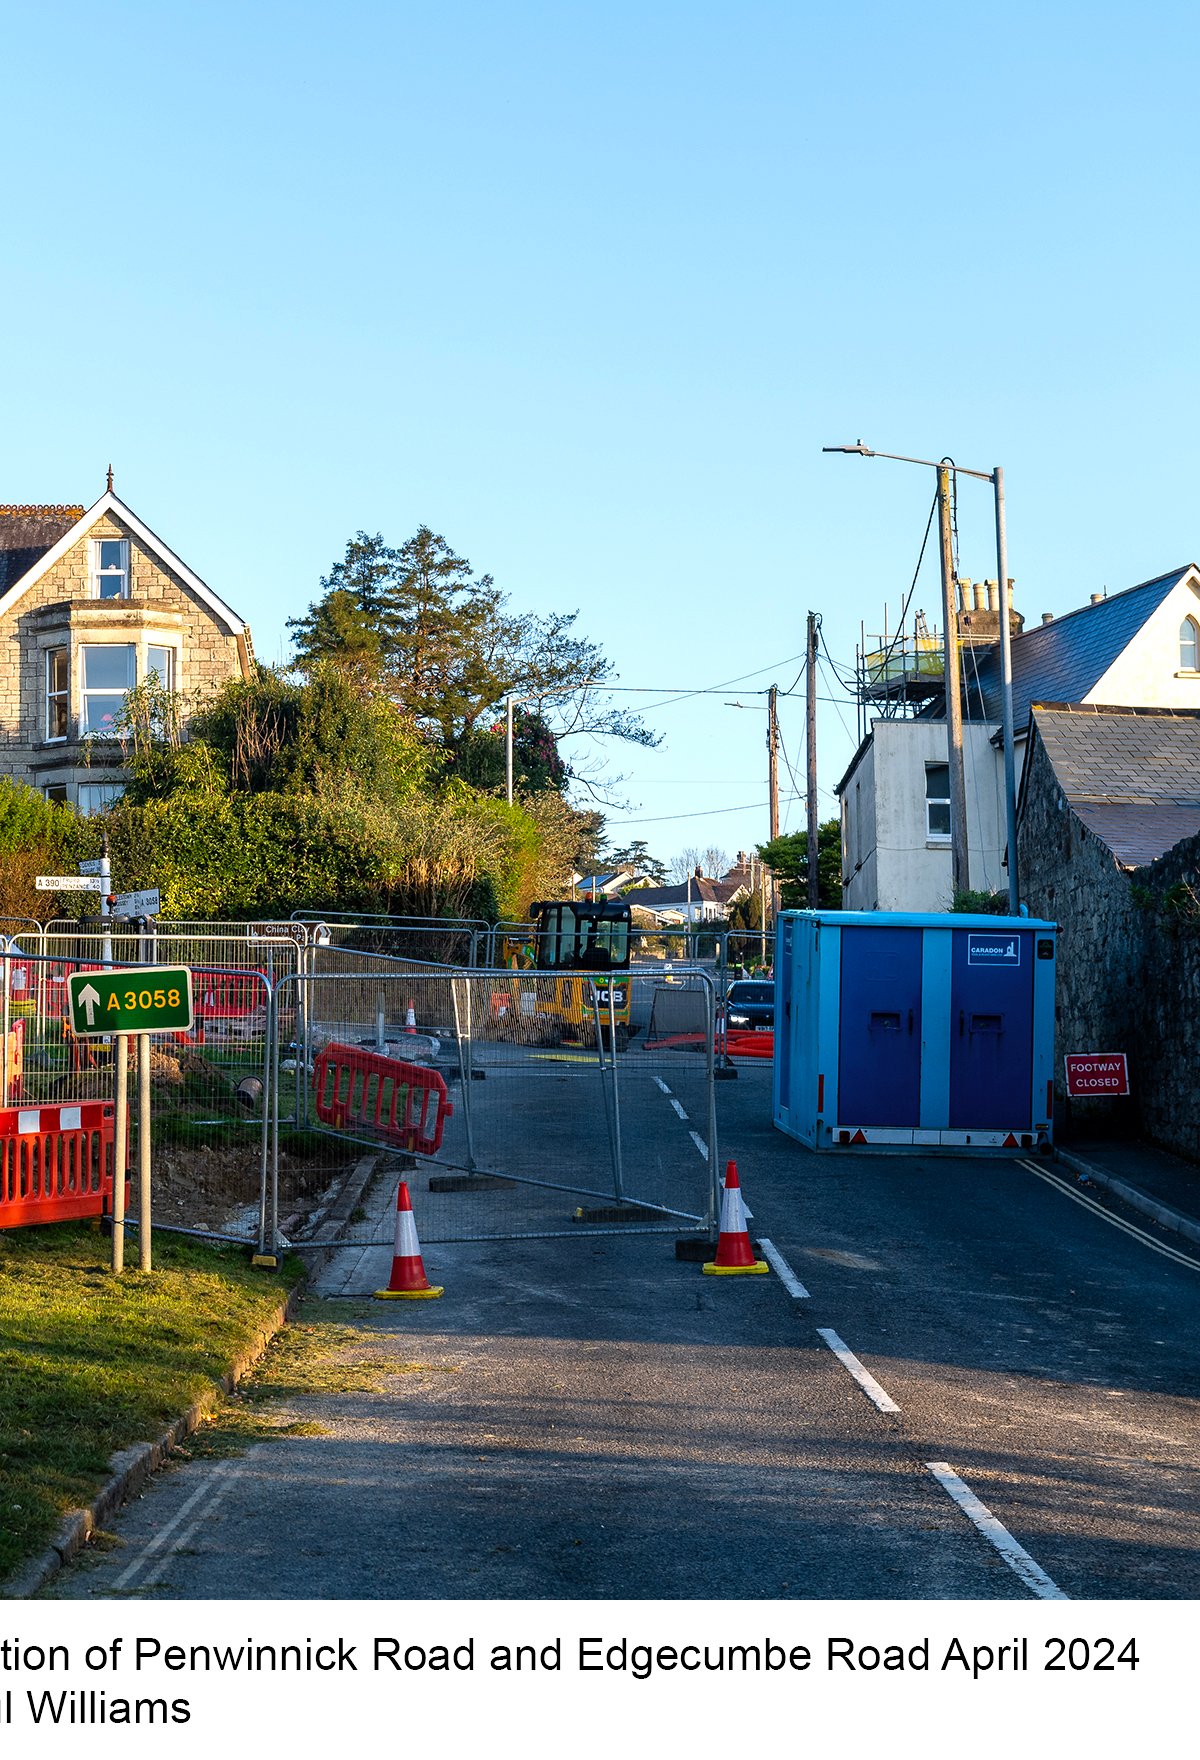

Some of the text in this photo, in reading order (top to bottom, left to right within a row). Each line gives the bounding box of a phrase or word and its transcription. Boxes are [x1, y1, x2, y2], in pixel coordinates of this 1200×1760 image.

[37, 878, 60, 887] A 390
[265, 925, 289, 933] China
[590, 990, 623, 1002] JCB
[1070, 1063, 1121, 1072] FOOTWAY
[1075, 1078, 1119, 1087] CLOSED
